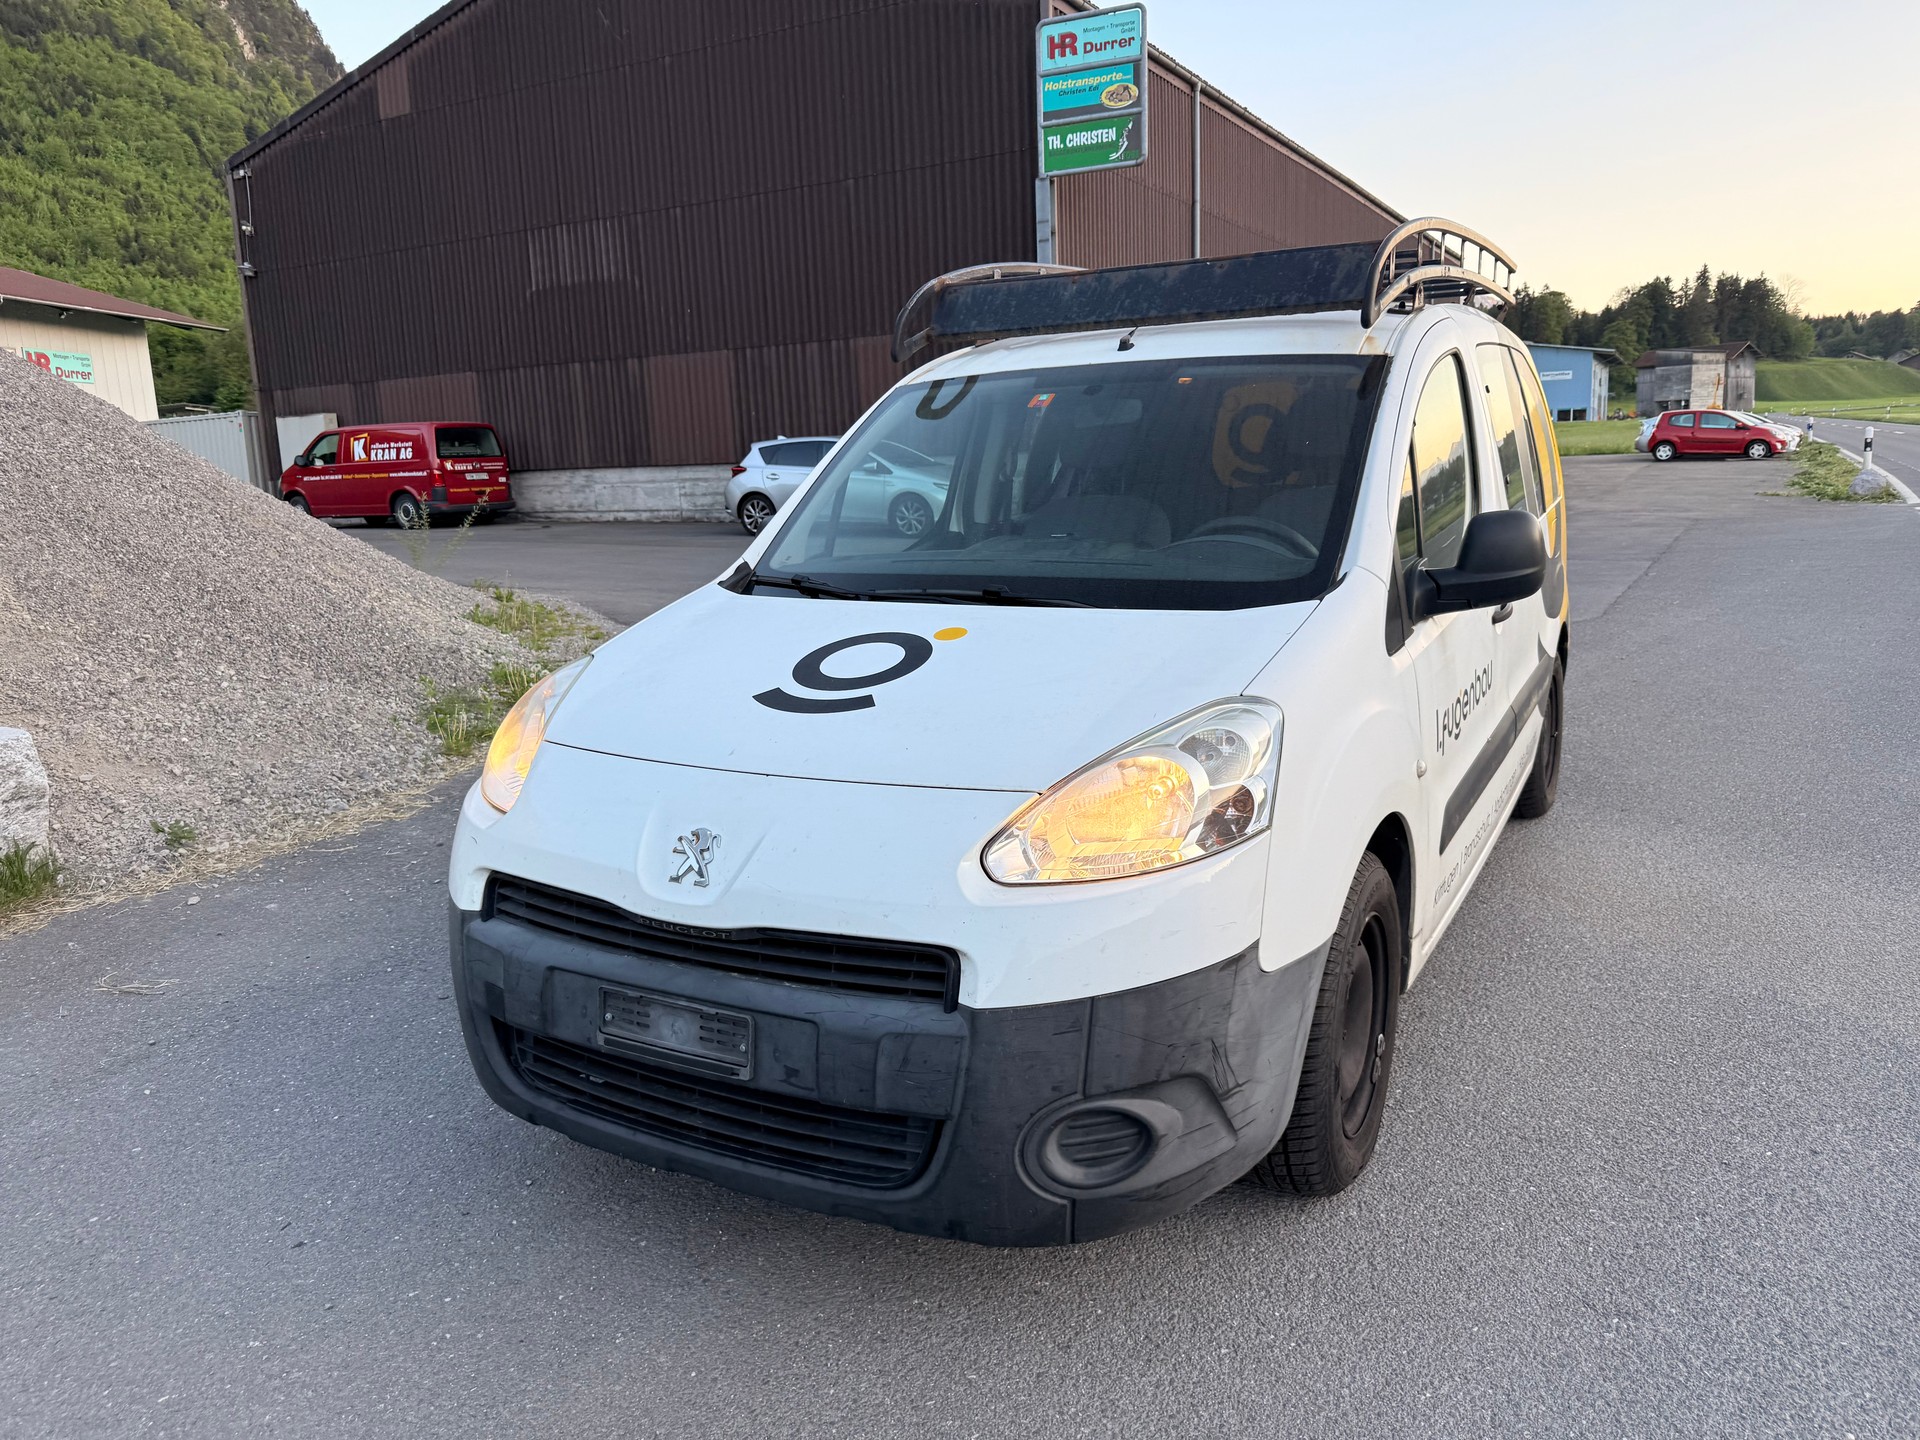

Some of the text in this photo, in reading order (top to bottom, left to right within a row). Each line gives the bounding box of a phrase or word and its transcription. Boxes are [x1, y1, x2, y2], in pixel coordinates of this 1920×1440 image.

[1047, 31, 1135, 60] HR Durrer
[1044, 71, 1123, 92] Holztransporte
[1058, 88, 1086, 97] Christen
[1047, 127, 1116, 150] TH. CHRISTEN
[55, 366, 92, 381] Durrer
[353, 438, 367, 461] K
[370, 447, 413, 461] KRAN AG
[639, 916, 729, 939] PEUGEOT
